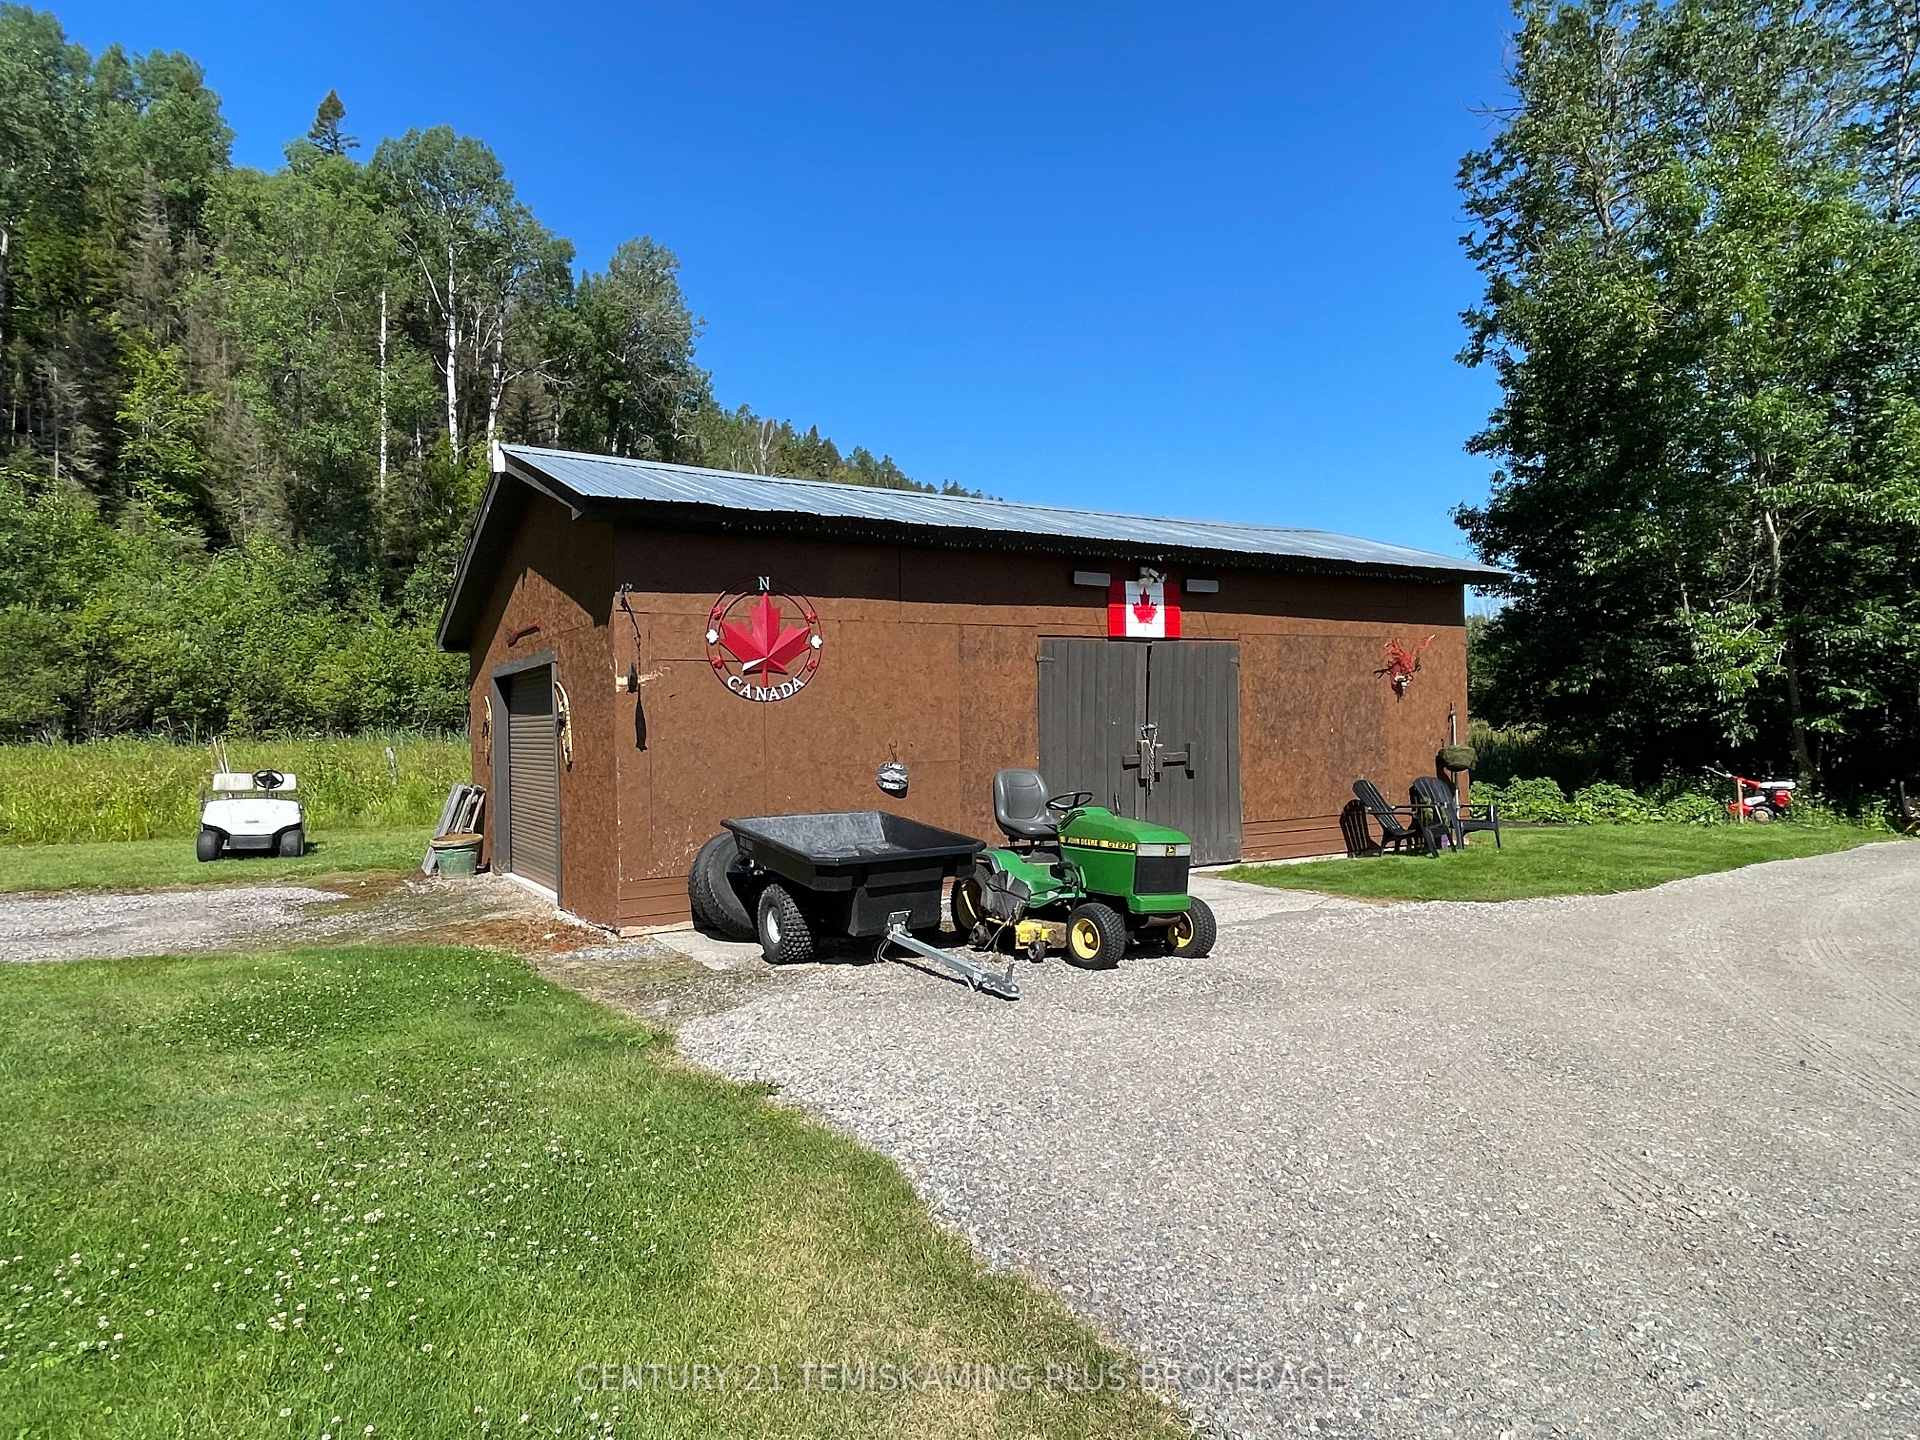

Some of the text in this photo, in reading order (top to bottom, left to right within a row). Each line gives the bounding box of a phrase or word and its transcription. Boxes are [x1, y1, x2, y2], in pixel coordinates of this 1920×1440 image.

[758, 576, 770, 591] N
[727, 675, 805, 701] CANADA
[1080, 838, 1098, 847] DEERE
